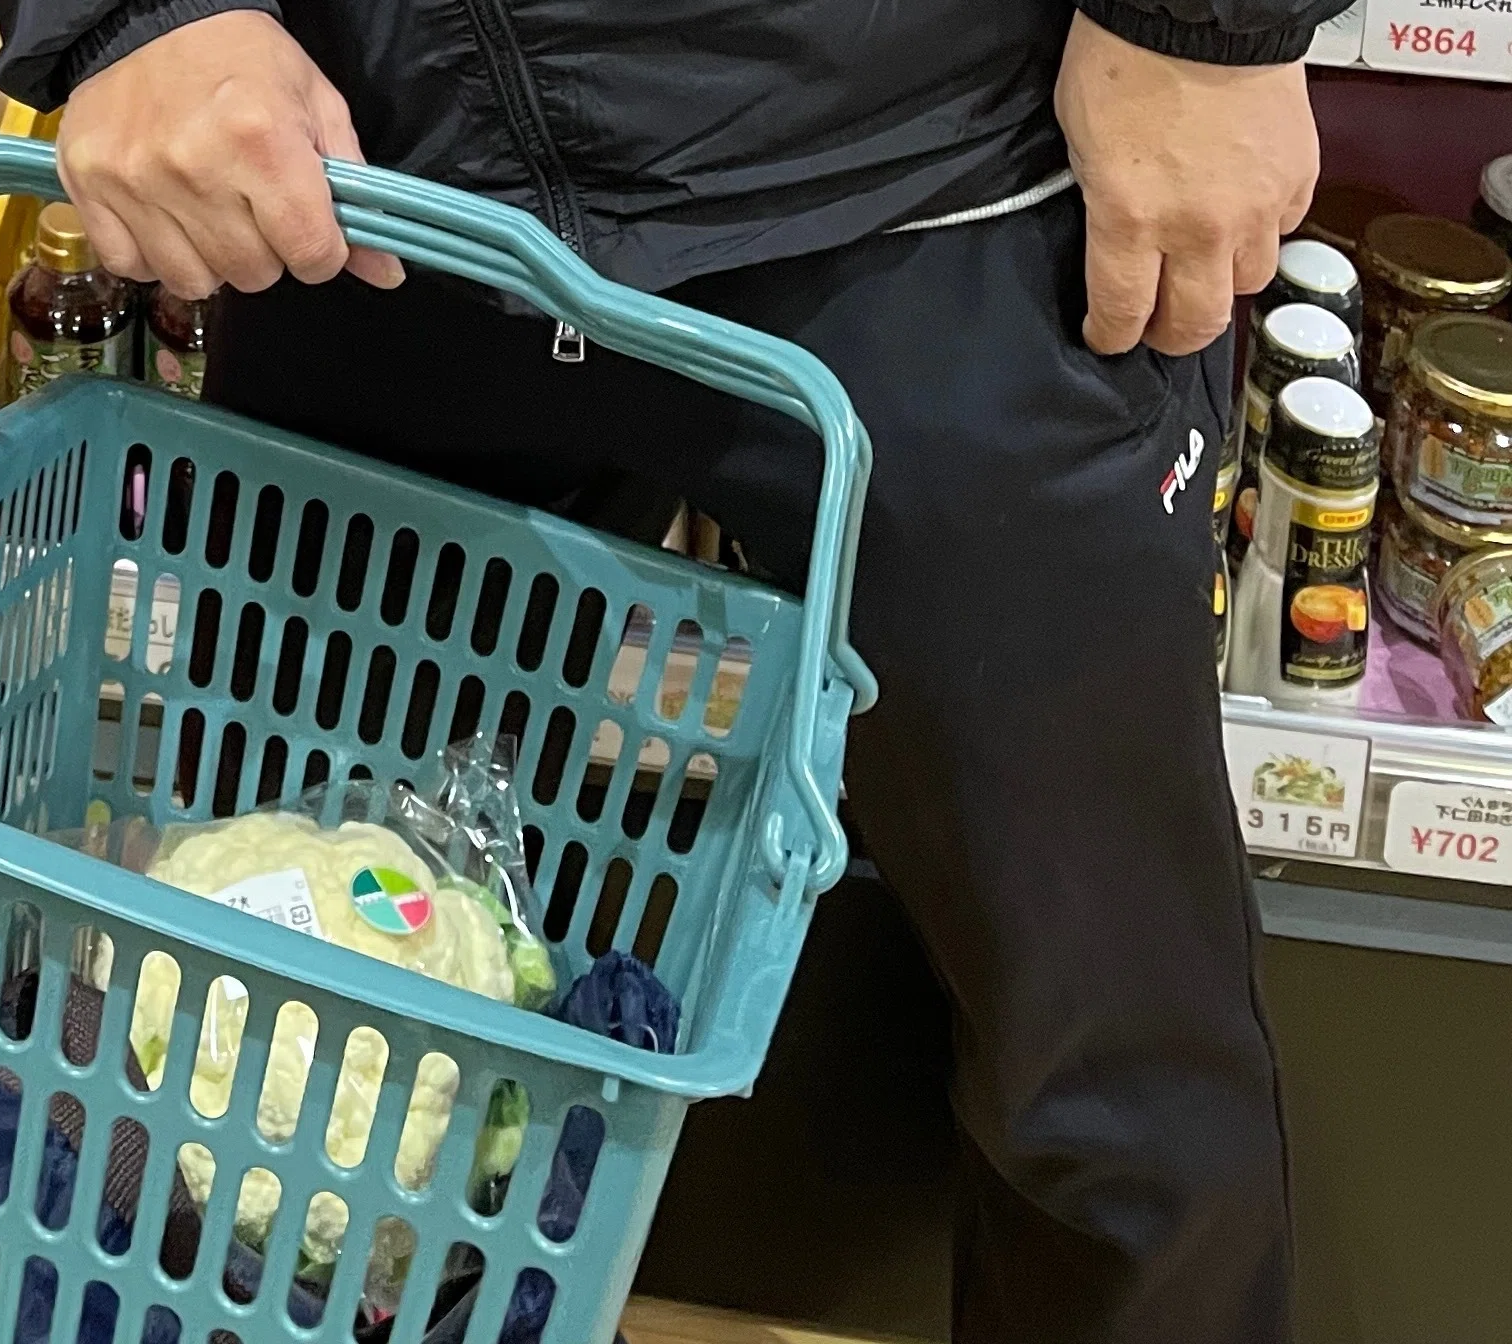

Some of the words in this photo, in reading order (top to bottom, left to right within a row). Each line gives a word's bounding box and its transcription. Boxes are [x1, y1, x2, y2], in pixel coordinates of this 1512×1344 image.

[1388, 21, 1477, 58] ¥864
[1160, 428, 1205, 515] FILA
[1411, 826, 1501, 864] ¥702
